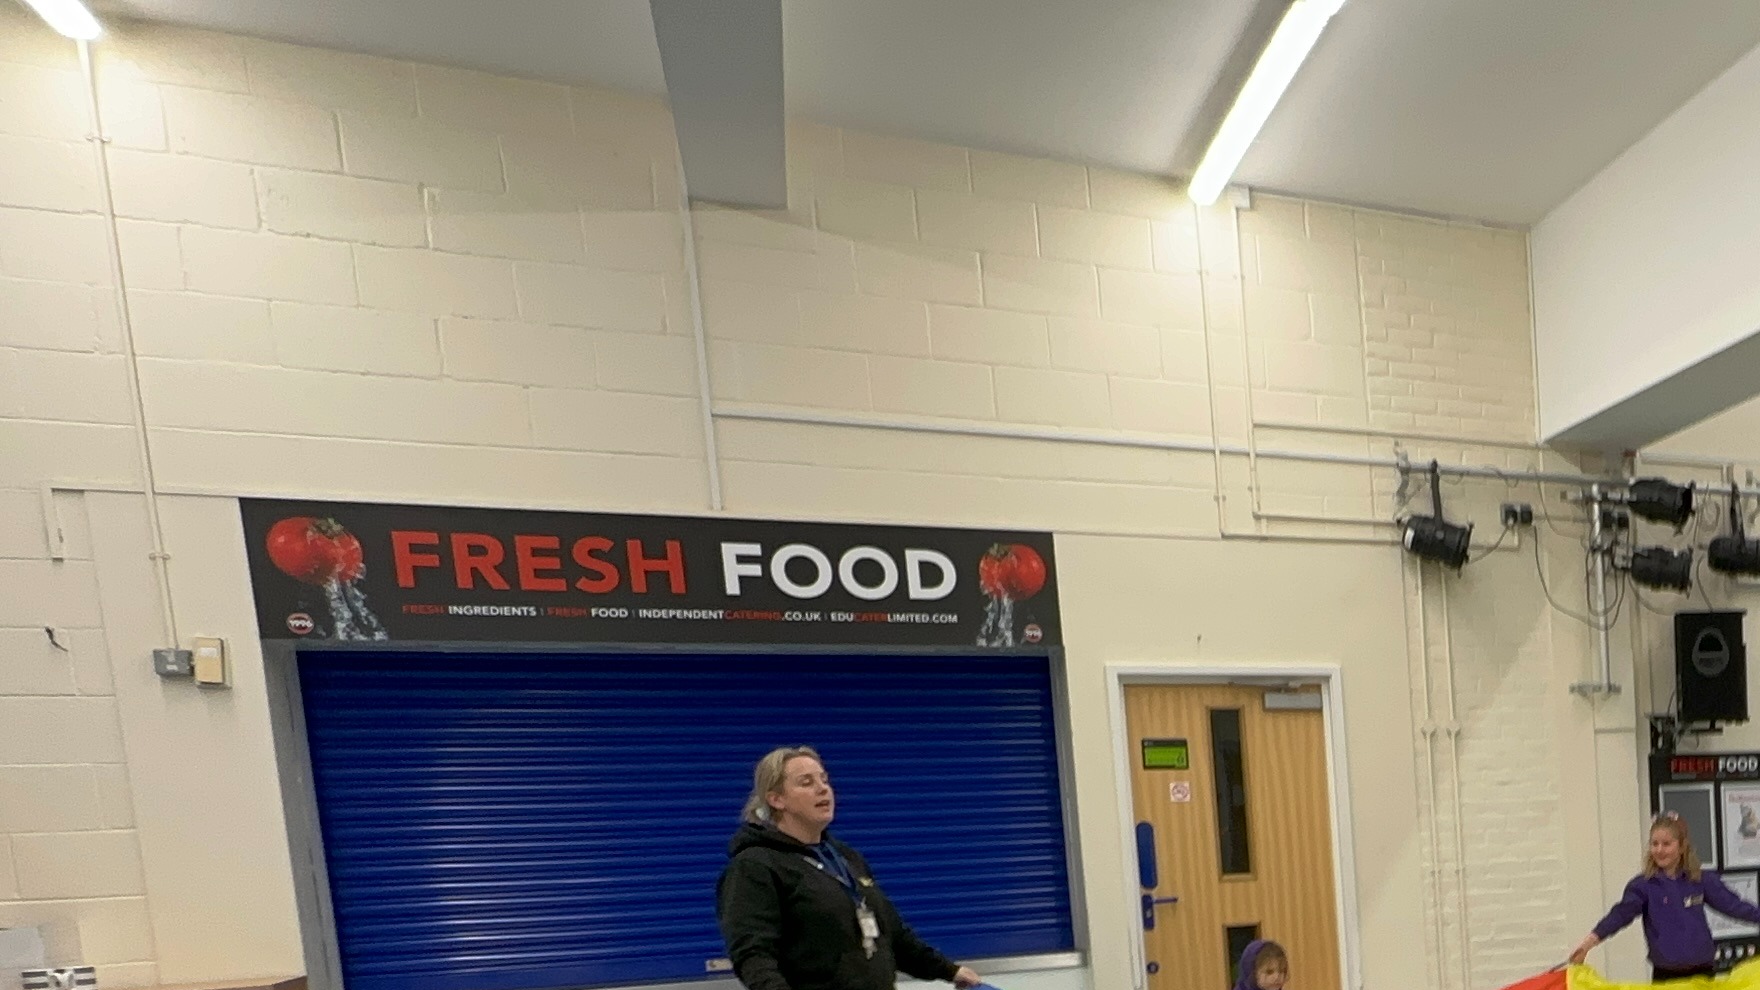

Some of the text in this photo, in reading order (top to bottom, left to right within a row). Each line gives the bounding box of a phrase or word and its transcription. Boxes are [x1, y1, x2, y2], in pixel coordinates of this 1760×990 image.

[391, 530, 957, 600] FRESH FOOD
[403, 604, 445, 615] FRESH
[448, 605, 537, 617] INGREDIENTS
[547, 606, 589, 618] FRESH
[591, 608, 629, 619] FOOD
[638, 609, 822, 622] INDEPENDENTCATERING.CO.UK
[1718, 755, 1758, 773] FOOD
